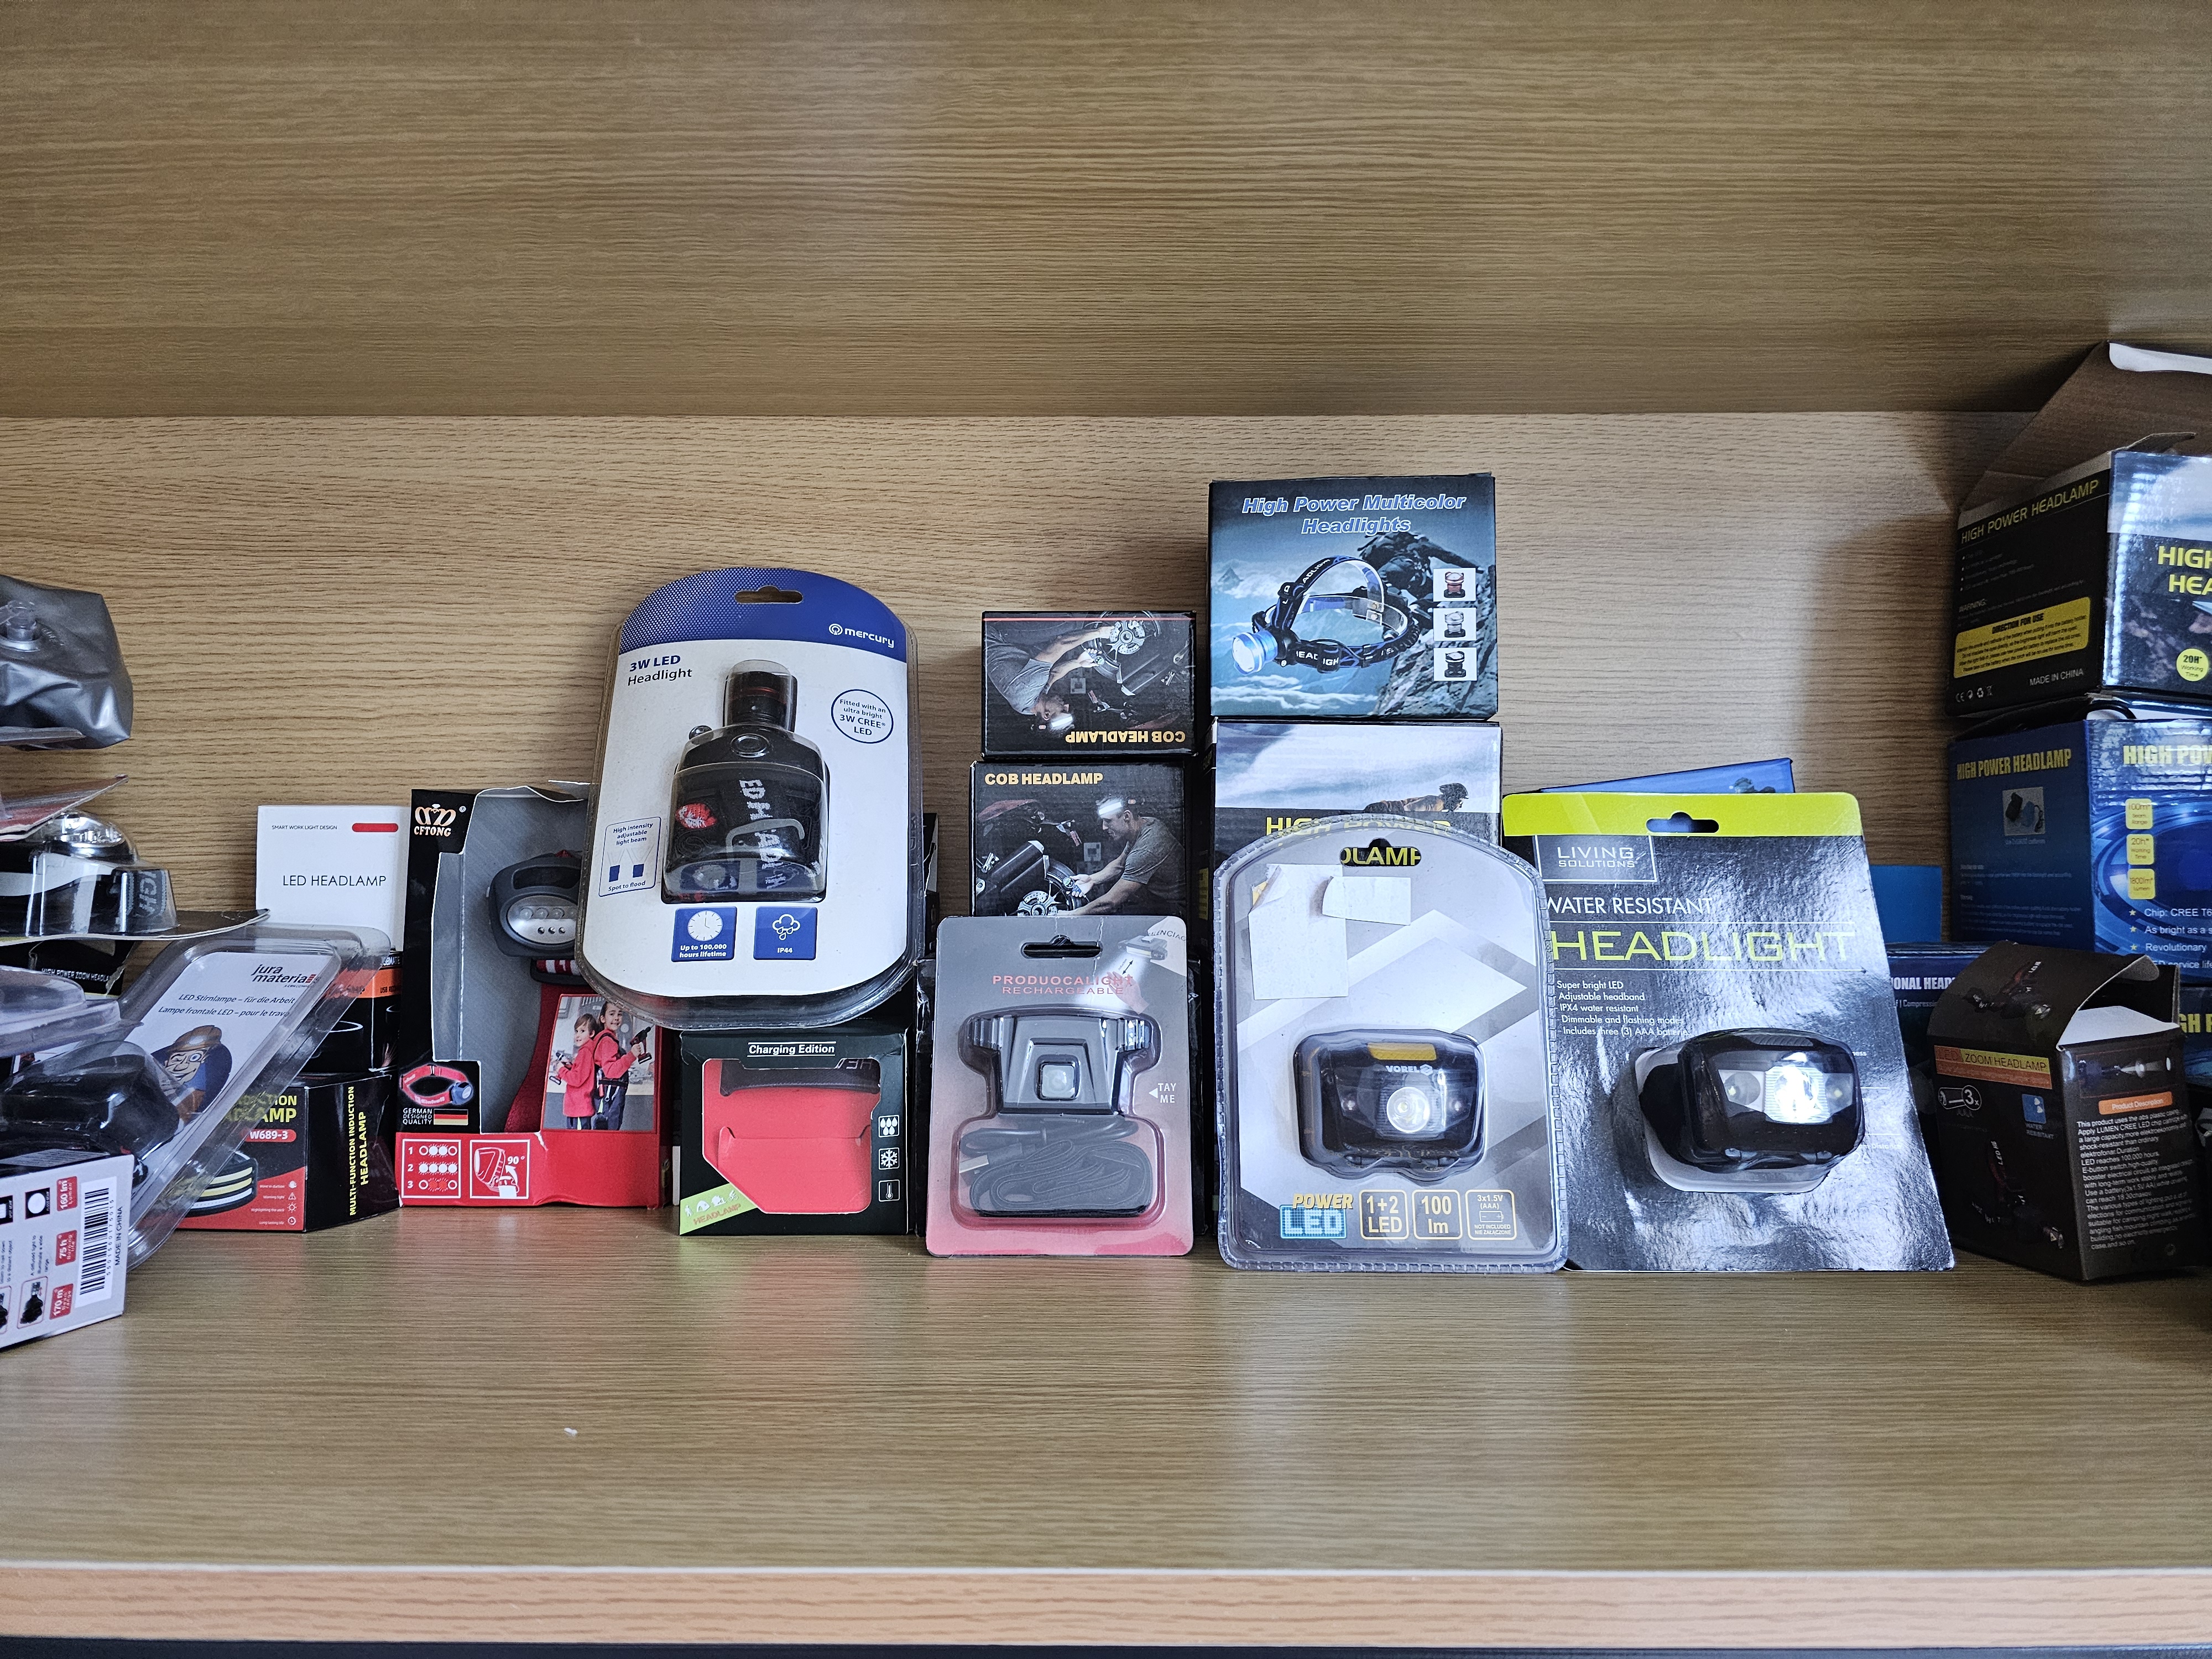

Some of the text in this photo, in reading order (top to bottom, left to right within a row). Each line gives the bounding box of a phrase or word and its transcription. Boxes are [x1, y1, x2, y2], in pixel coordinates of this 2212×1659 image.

[1242, 494, 1467, 517] High Power Multicolor
[1961, 480, 2099, 544] HIGH POWER HEADLAMP
[1301, 517, 1411, 535] Headlights
[1992, 613, 2044, 634] DIRECTION FOR USE
[844, 628, 894, 648] mercury
[629, 655, 681, 672] 3W LED
[628, 668, 692, 686] Headlight
[2030, 675, 2049, 686] MADE
[2060, 669, 2084, 679] CHINA
[839, 714, 855, 723] 3W
[862, 710, 882, 720] bright
[854, 726, 872, 735] LED
[1065, 731, 1185, 743] COB HEADLAMP
[2124, 745, 2172, 764] HIGH
[1957, 749, 2072, 780] HIGH POWER HEADLAMP
[985, 773, 1103, 785] COB HEADLAMP
[414, 826, 451, 837] CFTONG
[617, 830, 647, 838] adjustable
[1557, 847, 1634, 859] LIVING
[283, 875, 386, 886] LED HEADLAMP
[1547, 897, 1713, 914] WATER RESISTANT
[2145, 908, 2168, 917] Chip:
[2160, 926, 2185, 935] bright
[1551, 931, 1855, 961] HEADLIGHT
[2146, 943, 2206, 952] Revolutionary
[56, 970, 74, 979] POWER
[75, 971, 90, 980] ZOOM
[251, 964, 283, 975] jura
[993, 975, 1133, 985] PRODUOCALIGHT
[1557, 980, 1580, 990] Super
[1583, 980, 1606, 991] bright
[1559, 992, 1601, 1002] Adjustable
[1562, 1015, 1603, 1023] Dimmable
[1623, 1015, 1655, 1025] flashing
[1621, 1026, 1632, 1037] (3)
[749, 1044, 834, 1055] Charging Edition
[1965, 1054, 2046, 1071] ZOOM HEADLAMP
[1161, 1095, 1175, 1103] ME
[2135, 1098, 2164, 1107] Description
[2091, 1119, 2114, 1127] product
[250, 1130, 288, 1139] W689-3
[359, 1112, 368, 1185] HEADLAMP
[1292, 1193, 1354, 1209] POWER
[1366, 1196, 1399, 1214] 1+2
[1421, 1196, 1452, 1214] 100
[693, 1203, 741, 1225] HEADLAMP
[1284, 1209, 1342, 1235] LED
[1368, 1217, 1402, 1233] LED
[1428, 1219, 1448, 1234] lm
[116, 1234, 122, 1242] IN
